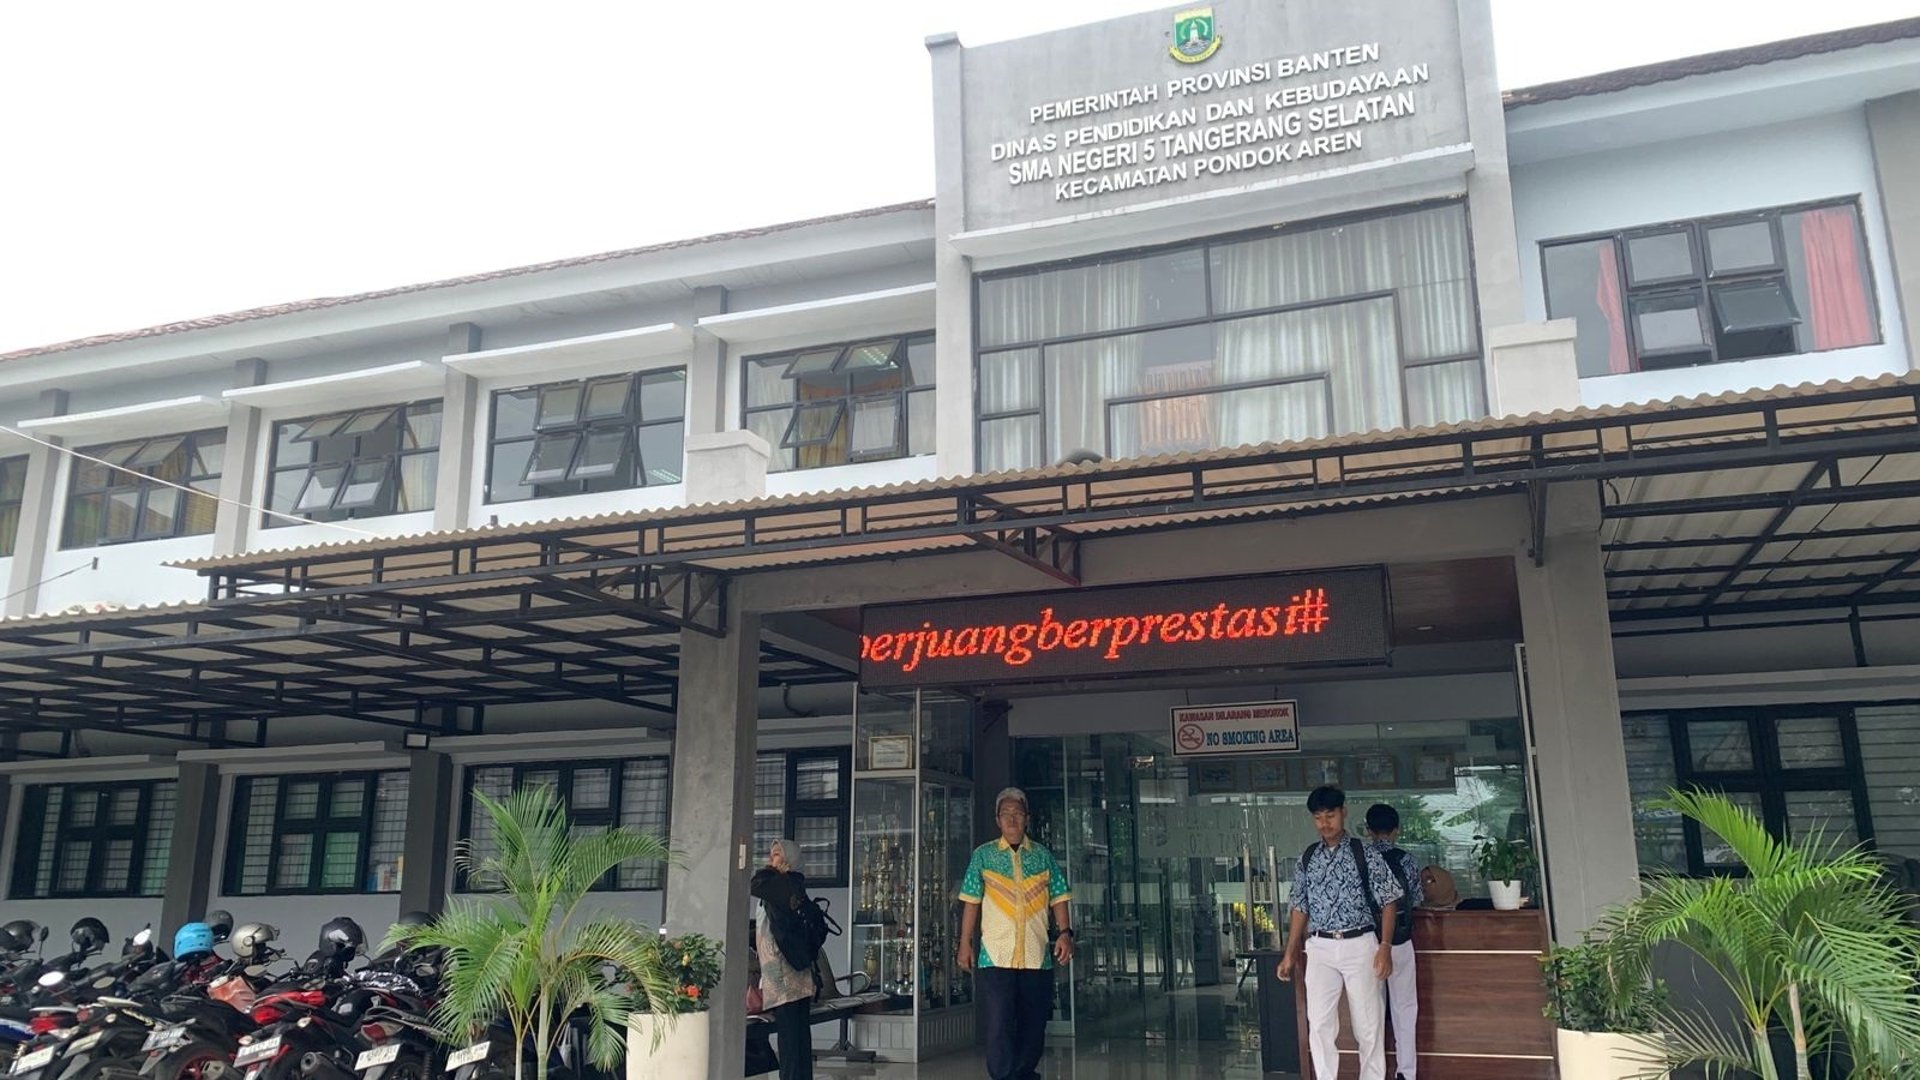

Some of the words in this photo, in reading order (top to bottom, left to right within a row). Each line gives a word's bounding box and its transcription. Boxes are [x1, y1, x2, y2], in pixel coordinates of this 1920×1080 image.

[991, 133, 1057, 161] DINAS
[1065, 107, 1196, 148] PENDIDIKAN
[1206, 96, 1254, 121] DAN
[1265, 63, 1429, 111] KEBUDAYAAN
[1030, 84, 1158, 124] PEMERINTAH
[1168, 61, 1271, 98] PROVINSI
[1277, 42, 1379, 78] BANTEN
[1008, 157, 1053, 185] SMA
[1058, 140, 1138, 176] NEGERI
[1143, 139, 1155, 162] 5
[1160, 112, 1301, 158] TANGERANG
[1308, 90, 1415, 132] SELATAN
[1056, 161, 1187, 201] KECAMATAN
[1194, 142, 1291, 178] PONDOK
[1296, 130, 1362, 159] AREN
[1206, 732, 1219, 746] NO
[1222, 729, 1266, 746] SMOKING
[1268, 729, 1294, 743] AREA
[1215, 709, 1252, 721] DILARANG
